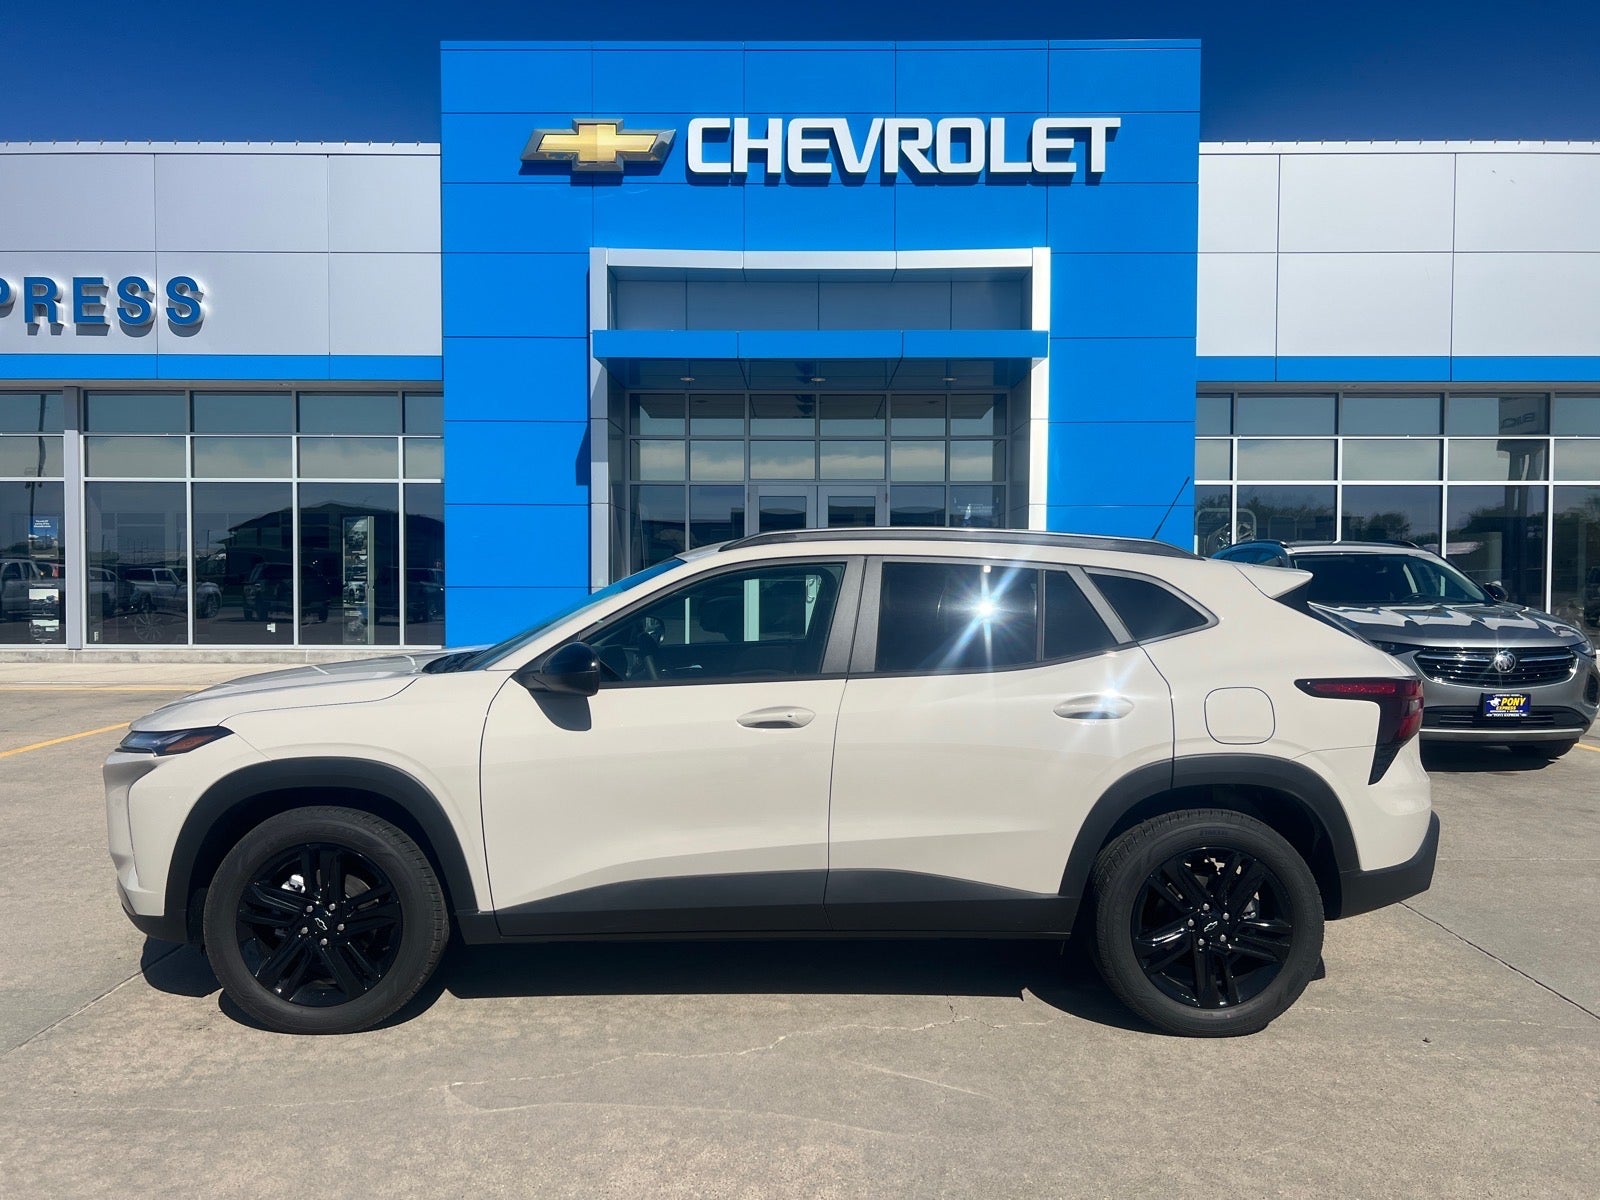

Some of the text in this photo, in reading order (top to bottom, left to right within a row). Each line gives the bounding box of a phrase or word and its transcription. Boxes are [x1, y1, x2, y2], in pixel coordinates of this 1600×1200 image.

[687, 117, 1122, 174] CHEVROLET
[0, 276, 203, 326] RESS
[1501, 697, 1526, 706] PONY
